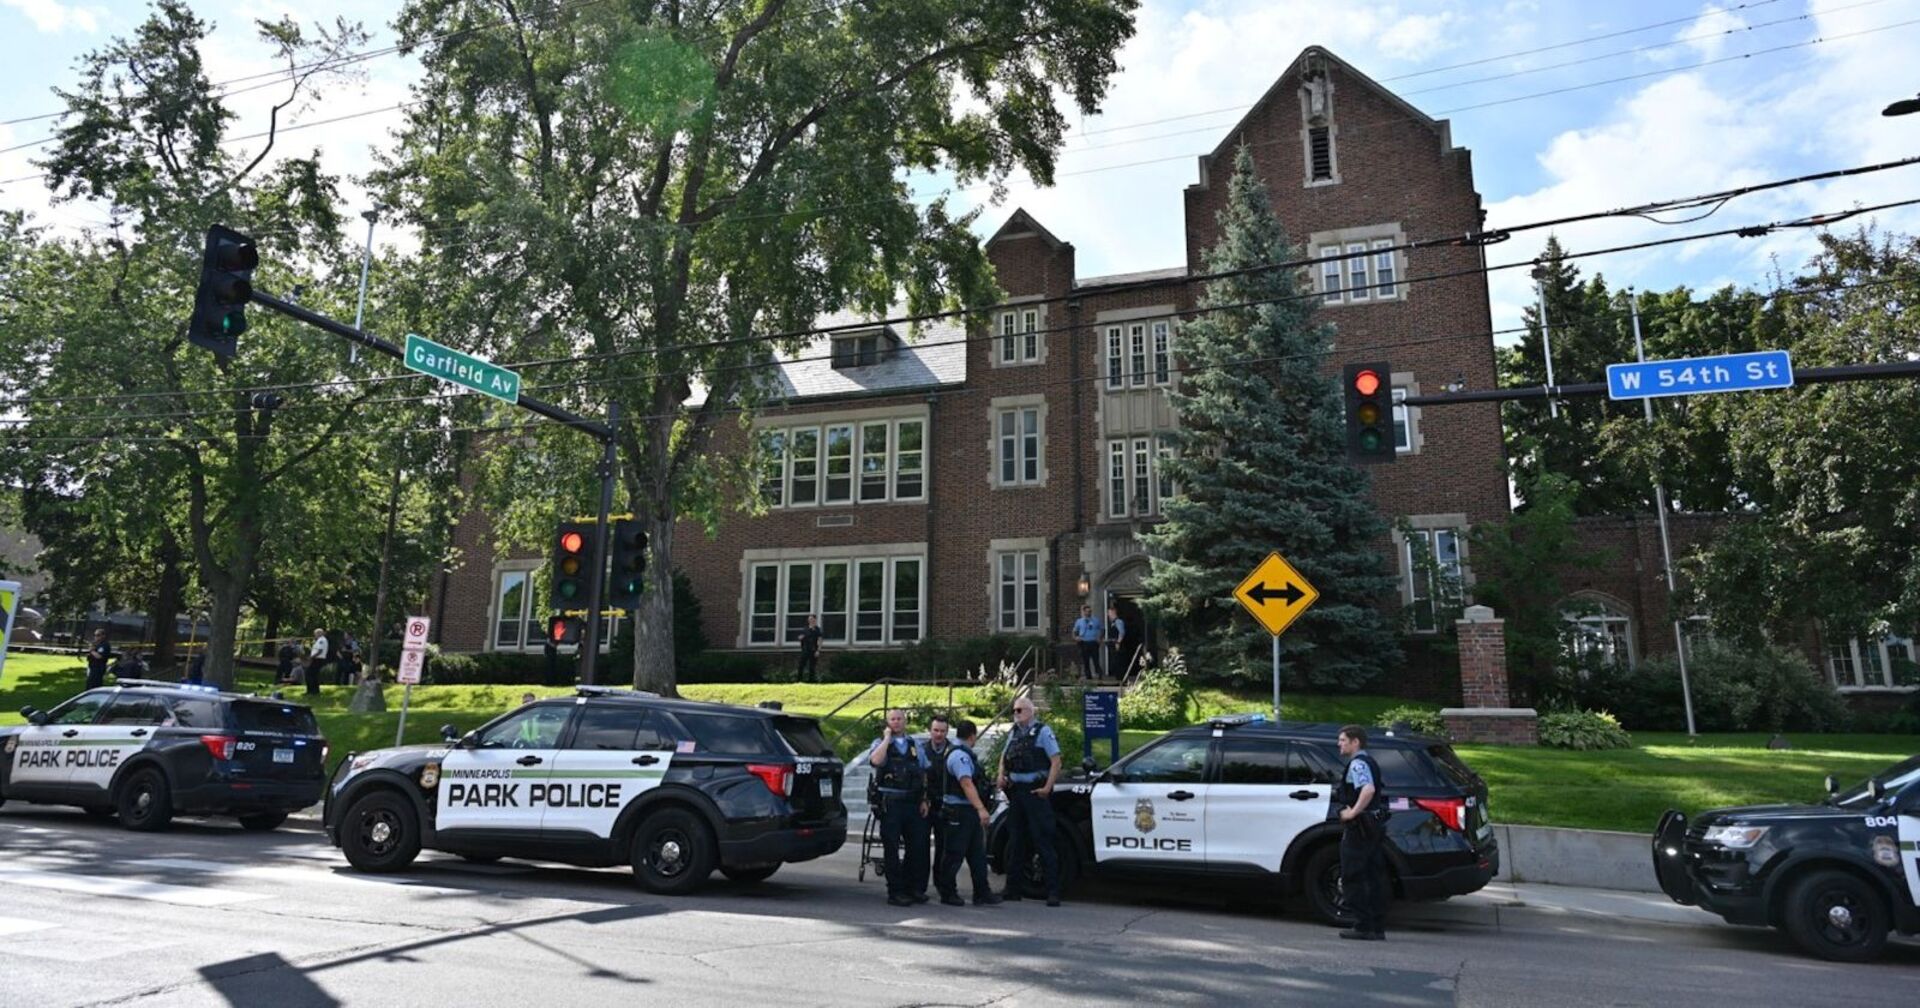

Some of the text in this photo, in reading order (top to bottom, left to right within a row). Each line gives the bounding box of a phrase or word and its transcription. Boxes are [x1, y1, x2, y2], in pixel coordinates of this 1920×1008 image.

[414, 346, 512, 393] Garfield Av
[1620, 361, 1779, 390] W 54th St
[236, 742, 256, 751] 820
[19, 749, 120, 768] PARK POLICE
[451, 769, 512, 778] MINNEAPOLIS
[796, 763, 812, 774] 850
[448, 783, 622, 807] PARK POLICE
[1865, 816, 1897, 828] 804
[1105, 836, 1192, 852] POLICE
